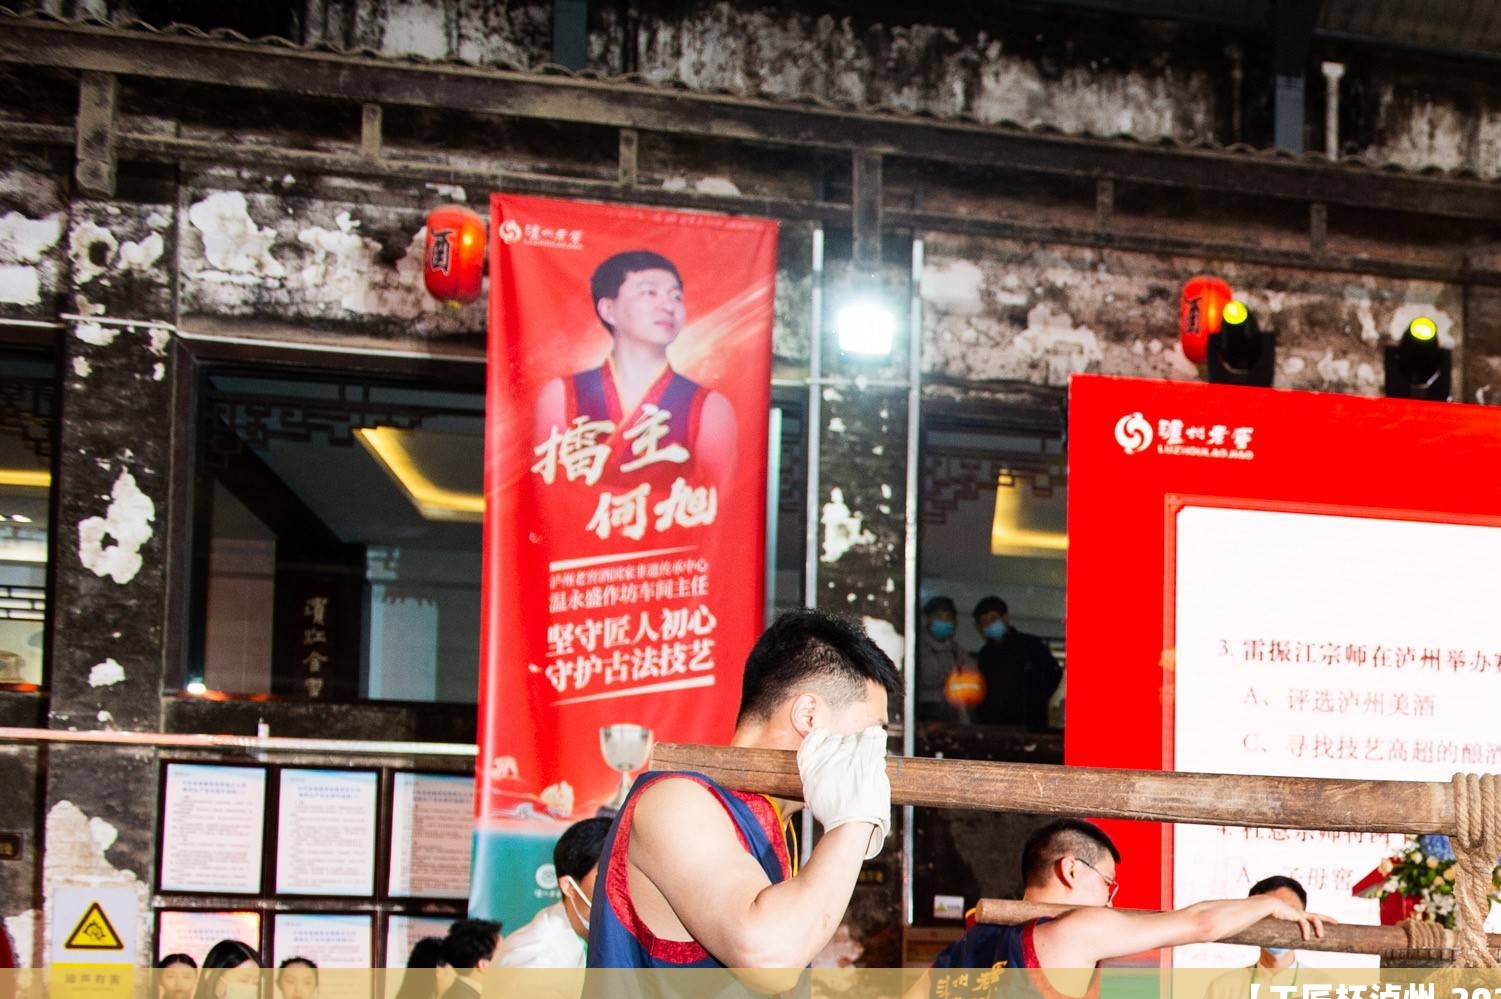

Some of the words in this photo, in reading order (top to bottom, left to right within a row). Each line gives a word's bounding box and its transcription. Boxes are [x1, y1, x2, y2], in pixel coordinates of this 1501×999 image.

[531, 404, 691, 486] 擂主
[586, 477, 719, 540] 何旭
[545, 604, 718, 658] 坚守匠人初心
[545, 638, 717, 693] 守护古法技艺
